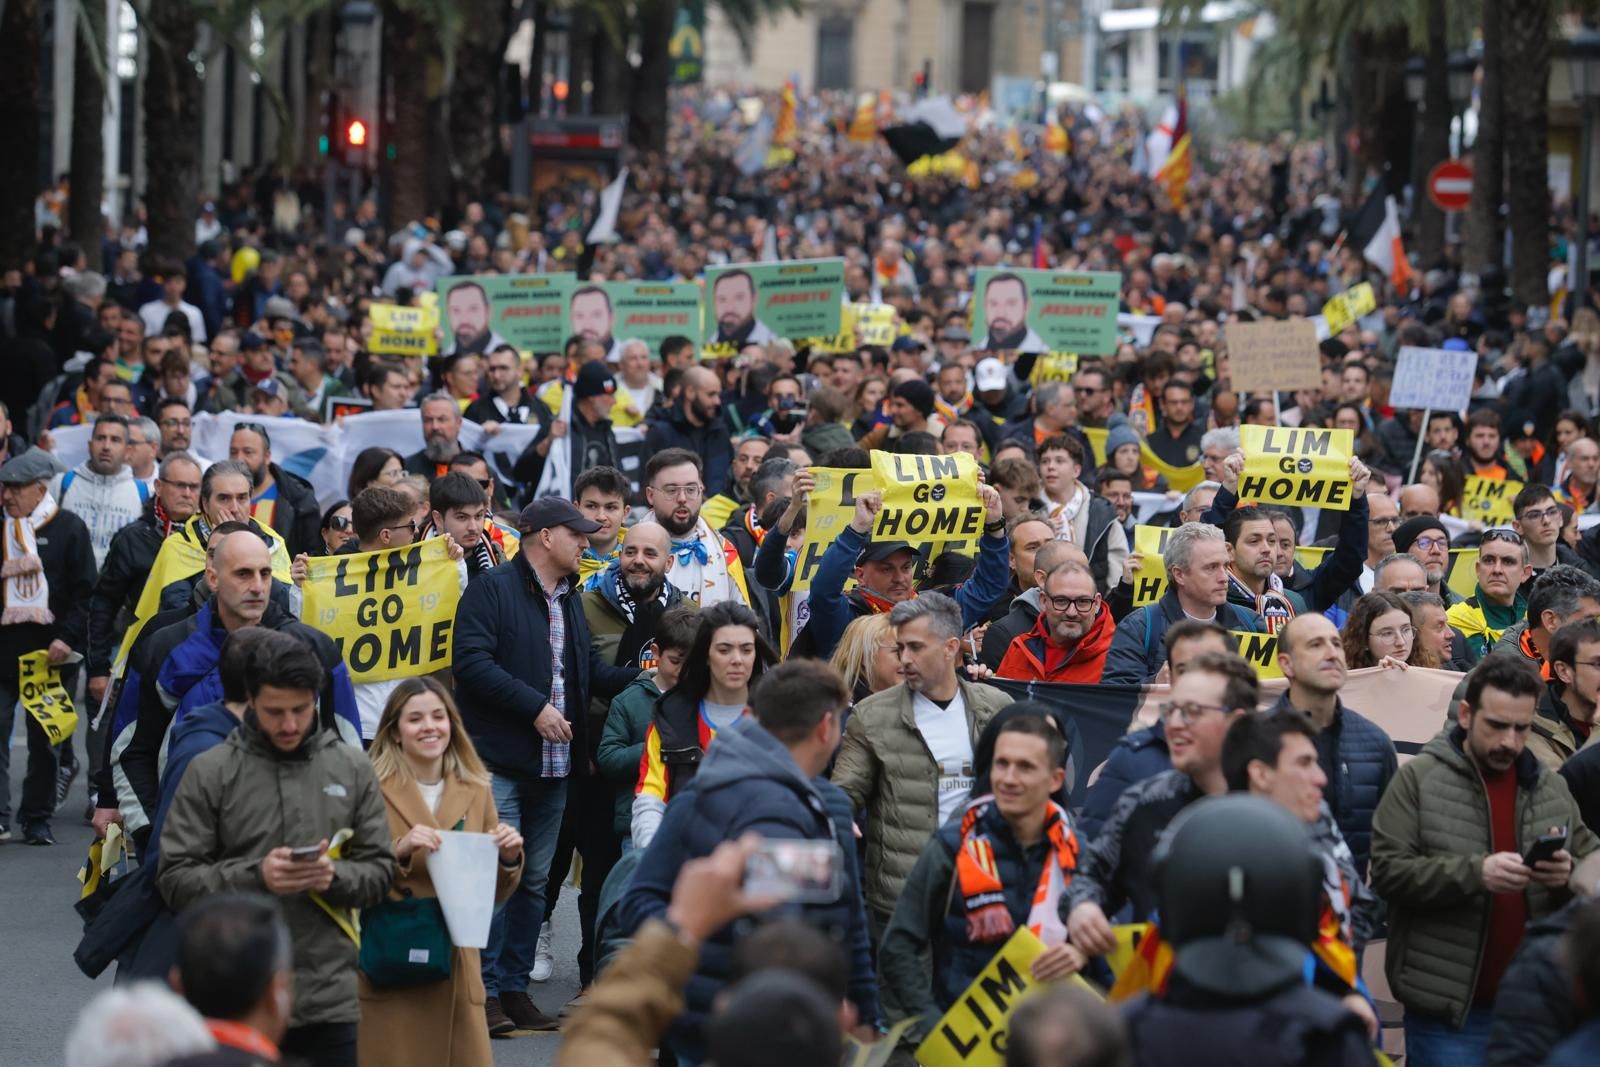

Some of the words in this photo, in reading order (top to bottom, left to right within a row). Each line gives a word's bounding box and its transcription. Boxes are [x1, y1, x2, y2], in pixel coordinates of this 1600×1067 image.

[380, 335, 425, 349] HOME
[1262, 428, 1331, 456] LIM
[893, 455, 960, 482] LIM
[1241, 476, 1348, 504] HOME
[876, 506, 982, 536] HOME
[335, 545, 422, 597] LIM
[357, 594, 404, 627] GO
[23, 660, 62, 738] HOME
[941, 956, 1027, 1060] LIM
